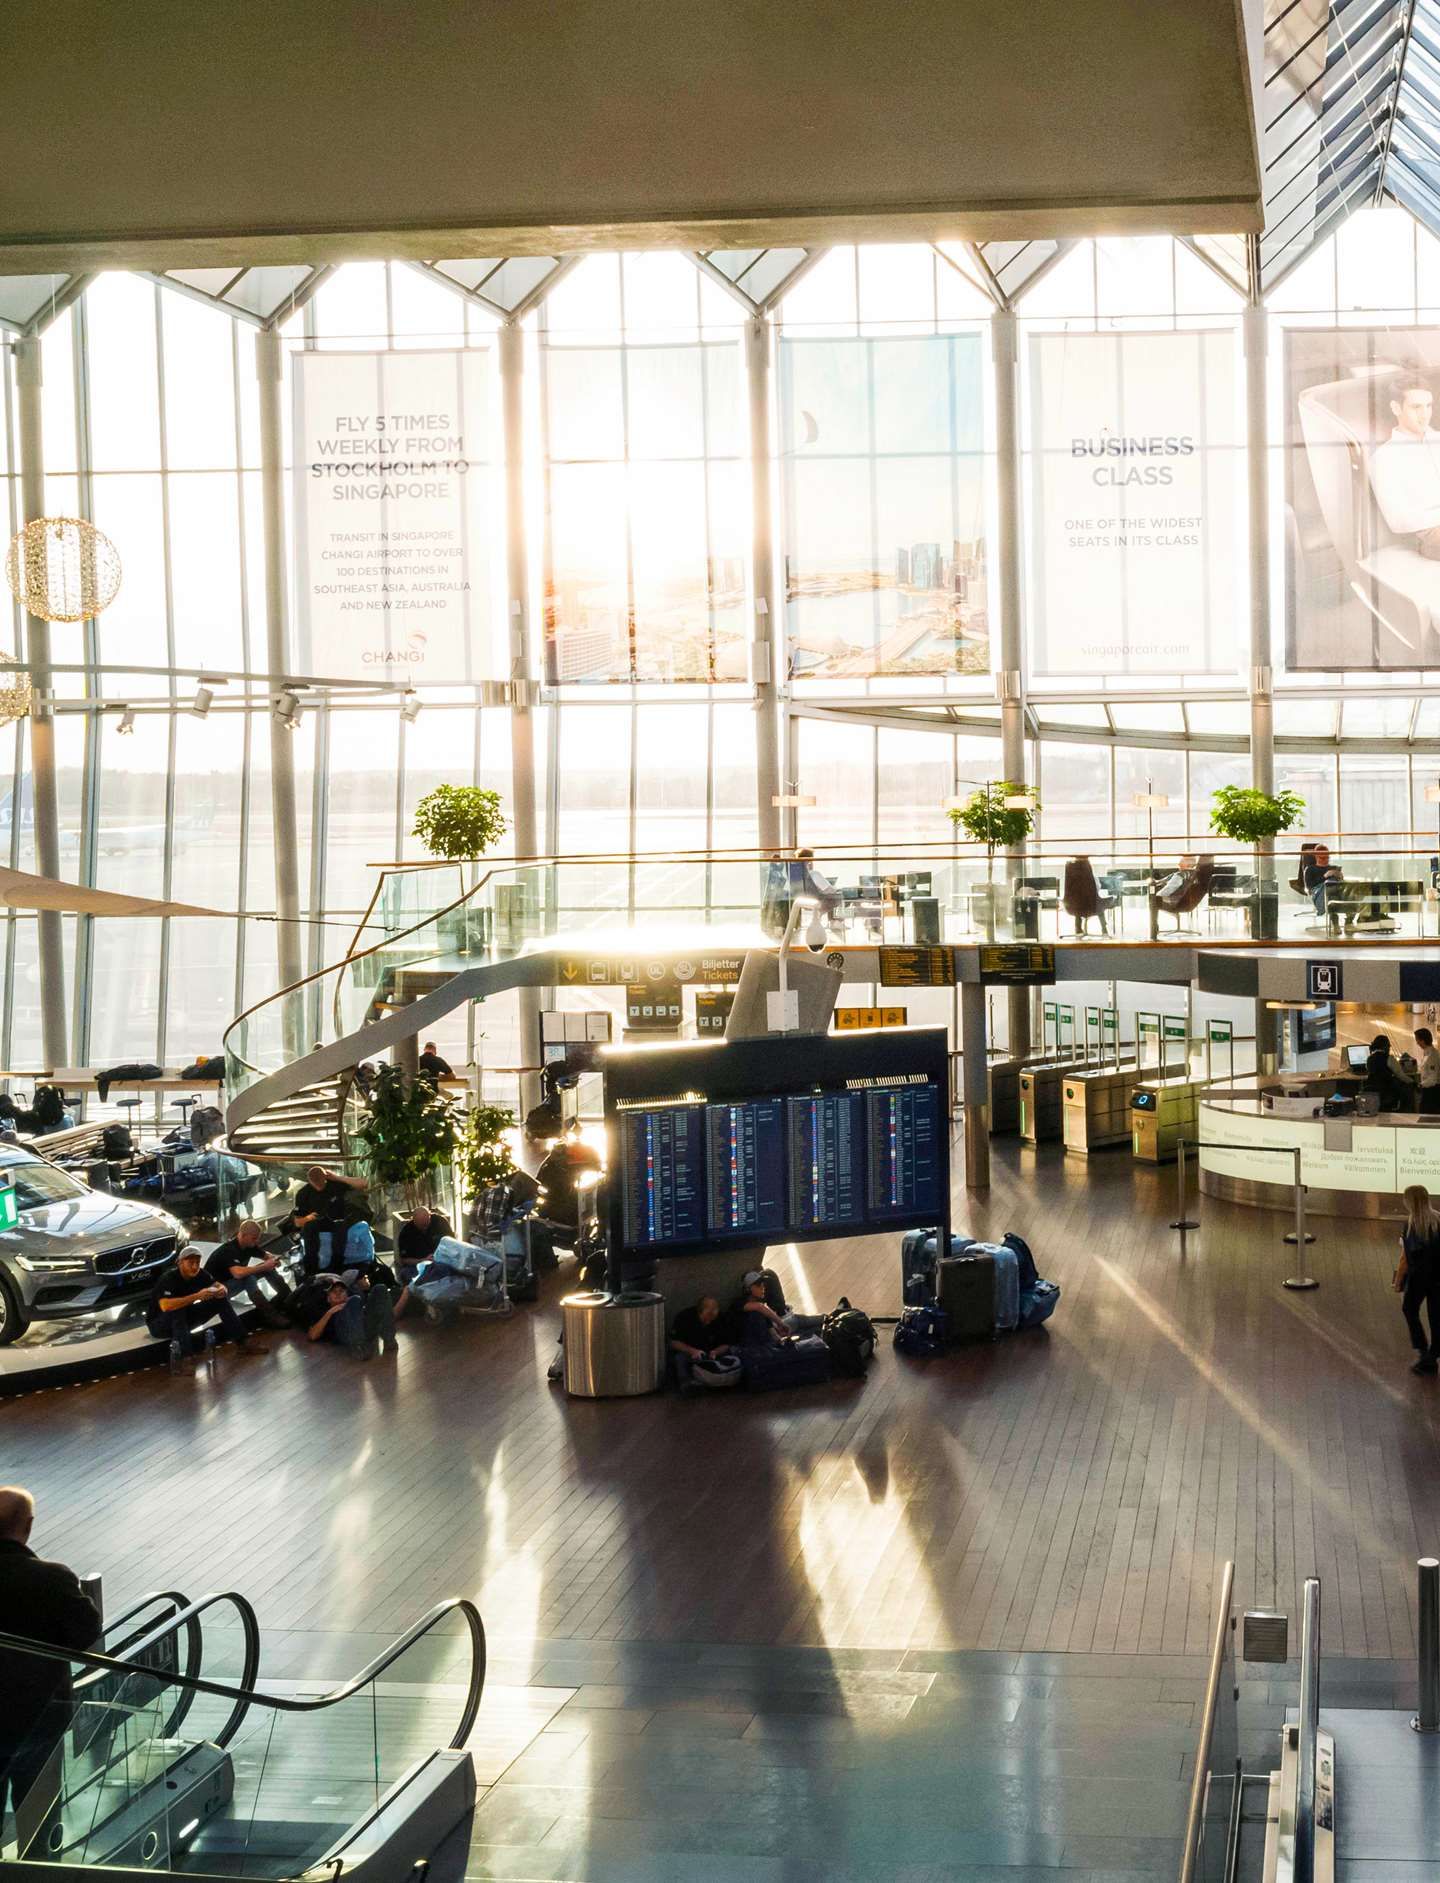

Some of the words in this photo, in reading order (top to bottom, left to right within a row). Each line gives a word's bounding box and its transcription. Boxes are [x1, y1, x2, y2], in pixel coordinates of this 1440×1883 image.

[336, 416, 369, 432] FLY
[375, 416, 385, 431] 5
[391, 415, 450, 431] TIMES
[317, 438, 399, 455] WEEKLY
[405, 436, 463, 453] FROM
[1071, 436, 1194, 458] BUSINESS
[311, 461, 436, 478] STOCKHOLM
[443, 459, 469, 475] TO
[1092, 466, 1173, 487] CLASS
[332, 483, 448, 500] SINGAPORE
[1064, 519, 1093, 530] ONE
[1097, 519, 1116, 529] OF
[1120, 518, 1146, 529] THE
[1150, 517, 1202, 528] WIDEST
[330, 533, 375, 543] TRANSIT
[378, 532, 388, 542] IN
[391, 531, 453, 541] SINGAPORE
[1069, 537, 1110, 547] SEATS
[1114, 536, 1127, 546] IN
[1132, 536, 1151, 546] ITS
[1156, 535, 1199, 546] CLASS
[321, 550, 363, 560] CHANGI
[366, 549, 413, 559] AIRPORT
[416, 549, 429, 558] TO
[431, 547, 463, 557] OVER
[337, 567, 355, 577] 100
[357, 566, 434, 576] DESTINATIONS
[437, 565, 448, 574] IN
[314, 583, 378, 594] SOUTHEAST
[411, 581, 471, 592] AUSTRALIA
[340, 600, 363, 610] AND
[366, 600, 392, 610] NEW
[395, 599, 446, 609] ZEALAND
[361, 651, 424, 664] CHANGI
[702, 960, 740, 971] Biljetter
[702, 971, 738, 980] Tickets
